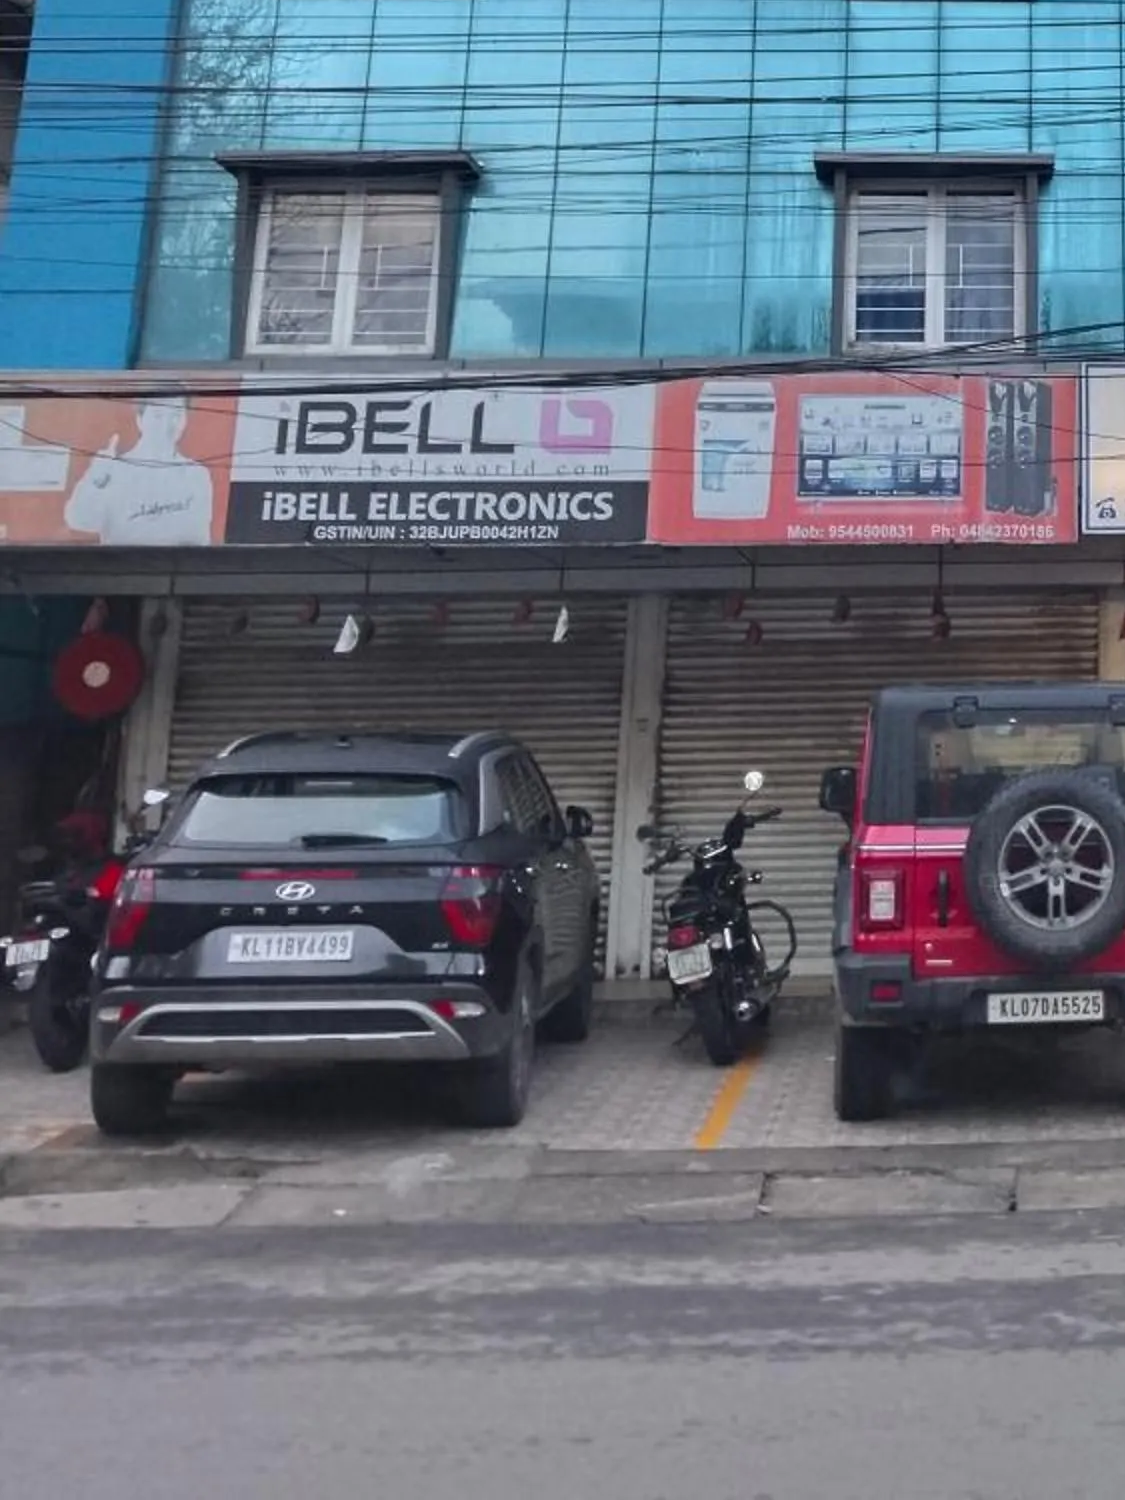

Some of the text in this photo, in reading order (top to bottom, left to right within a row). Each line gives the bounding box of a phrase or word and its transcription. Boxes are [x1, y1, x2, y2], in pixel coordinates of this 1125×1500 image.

[274, 399, 516, 455] iBELL
[261, 491, 614, 521] iBELL ELECTRONICS
[313, 525, 396, 540] GSTIN/UIN
[1000, 995, 1101, 1017] KL07DA5525
